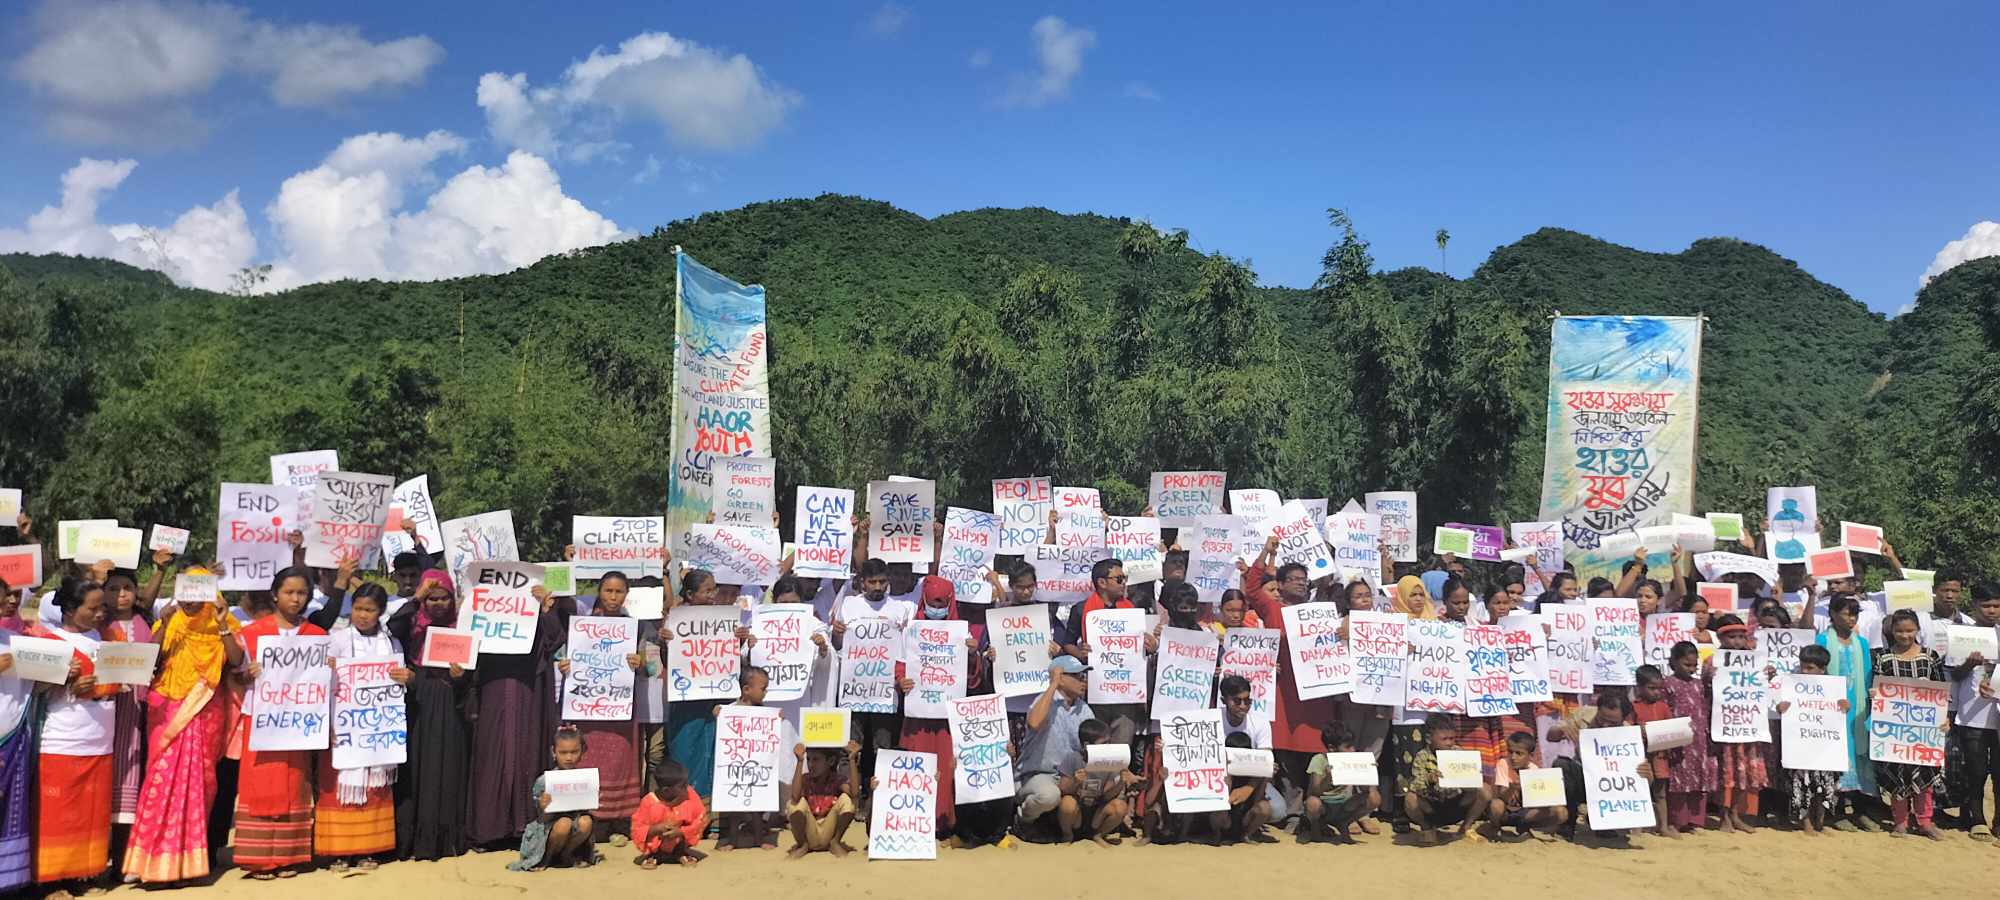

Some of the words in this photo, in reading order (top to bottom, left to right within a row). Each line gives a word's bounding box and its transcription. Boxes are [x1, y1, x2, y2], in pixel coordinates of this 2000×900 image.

[728, 395, 768, 410] JUSTICE
[696, 405, 754, 433] HAOR
[693, 417, 753, 455] YOUTH
[1575, 447, 1649, 479] হাওর
[731, 474, 773, 489] FORESTS
[1163, 474, 1224, 489] PROMOTE
[238, 491, 280, 513] END
[727, 487, 744, 500] GO
[879, 491, 920, 508] SAVE
[1063, 492, 1101, 509] SAVE
[1158, 489, 1212, 504] GREEN
[727, 501, 764, 513] GREEN
[805, 493, 847, 514] CAN
[1157, 503, 1214, 518] ENERGY
[723, 510, 753, 523] SAVE
[886, 506, 933, 522] RIVER
[1003, 502, 1048, 526] NOT
[612, 518, 658, 533] STOP
[809, 514, 842, 532] WE
[881, 522, 924, 538] SAVE
[1346, 518, 1367, 531] WE
[583, 532, 660, 546] CLIMATE
[803, 530, 848, 550] EAT
[879, 536, 922, 553] LIFE
[1000, 527, 1046, 549] PROF
[1060, 532, 1101, 548] SAVE
[1280, 532, 1310, 553] NOT
[1348, 532, 1377, 546] WANT
[578, 546, 665, 562] IMPERIALISM
[713, 527, 775, 577] PROMOTE
[798, 548, 848, 566] MONEY
[953, 545, 985, 564] OUR
[1036, 546, 1101, 562] ENSURE
[1337, 546, 1379, 562] CLIMATE
[1063, 563, 1093, 575] FOO
[477, 567, 530, 589] END
[471, 587, 535, 618] FOSSIL
[470, 614, 529, 640] FUEL
[676, 618, 739, 638] CLIMATE
[1001, 615, 1033, 631] OUR
[1299, 621, 1334, 638] LOSS
[1554, 611, 1587, 632] END
[1655, 616, 1680, 632] WE
[854, 623, 893, 641] OUR
[1005, 631, 1045, 647] EARTH
[1419, 625, 1456, 640] OUR
[1766, 630, 1794, 647] NO
[1166, 639, 1217, 662] PROMOTE
[1229, 634, 1279, 652] PROMOTE
[262, 643, 331, 669] PROMOTE
[847, 645, 890, 660] HAOR
[1015, 650, 1027, 665] IS
[1223, 649, 1277, 668] GLOBAL
[1411, 644, 1461, 664] HAOR
[1733, 653, 1755, 668] AM
[1766, 645, 1801, 659] MOR
[690, 660, 736, 679] NOW
[853, 662, 893, 677] OUR
[1161, 664, 1214, 687] GREEN
[1315, 662, 1351, 681] FUND
[1422, 665, 1455, 680] OUR
[1548, 668, 1588, 690] FUEL
[1728, 670, 1763, 687] THE
[259, 680, 328, 706] GREEN
[1158, 682, 1209, 709] ENERGY
[1721, 686, 1749, 702] SON
[1750, 690, 1765, 702] OF
[1794, 681, 1825, 697] OUR
[1721, 703, 1761, 715] MOHA
[255, 711, 329, 737] ENERGY
[1721, 714, 1753, 726] DEW
[1798, 712, 1824, 726] OUR
[1721, 726, 1759, 738] RIVER
[1799, 726, 1841, 742] RIGHTS
[891, 755, 926, 773] OUR
[887, 770, 933, 795] HAOR
[1598, 776, 1638, 793] OUR
[889, 793, 926, 813] OUR
[1598, 799, 1649, 819] PLANET
[884, 811, 933, 834] RIGHTS
